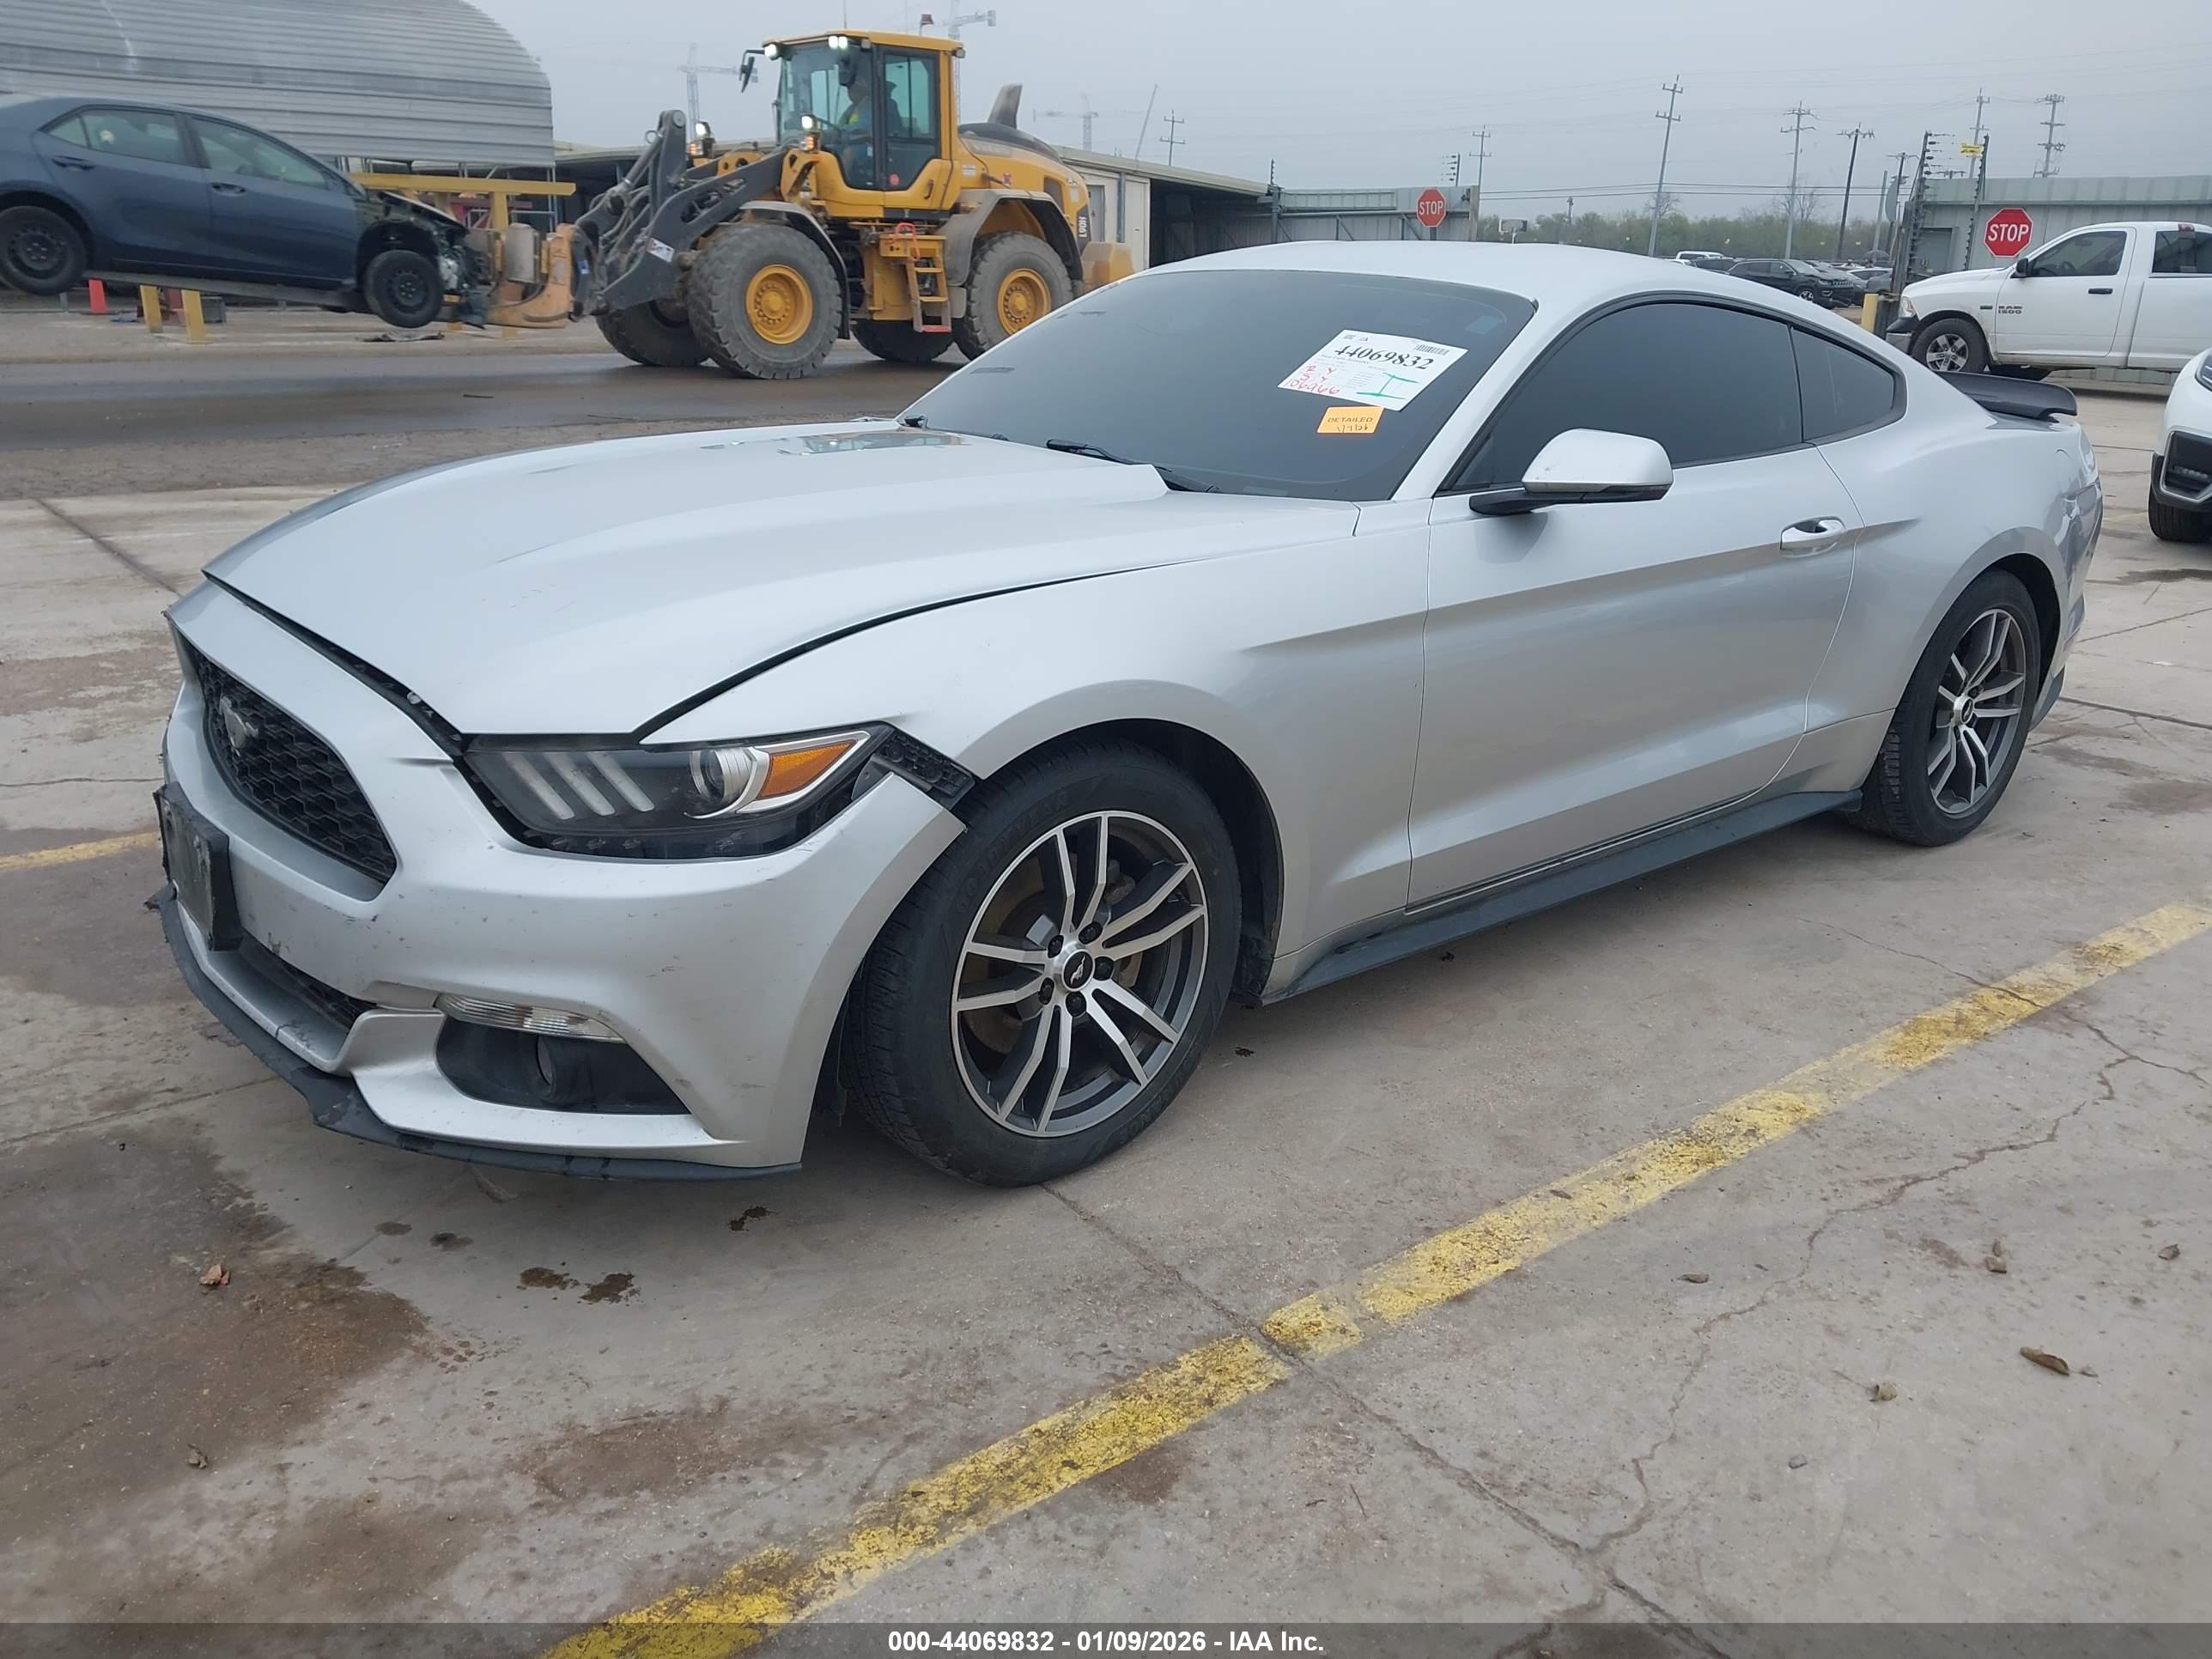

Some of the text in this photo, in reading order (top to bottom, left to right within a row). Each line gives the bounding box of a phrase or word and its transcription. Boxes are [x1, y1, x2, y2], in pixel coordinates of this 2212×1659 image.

[1419, 200, 1444, 216] STOP
[1988, 223, 2030, 242] STOP
[1334, 344, 1435, 370] 44069832
